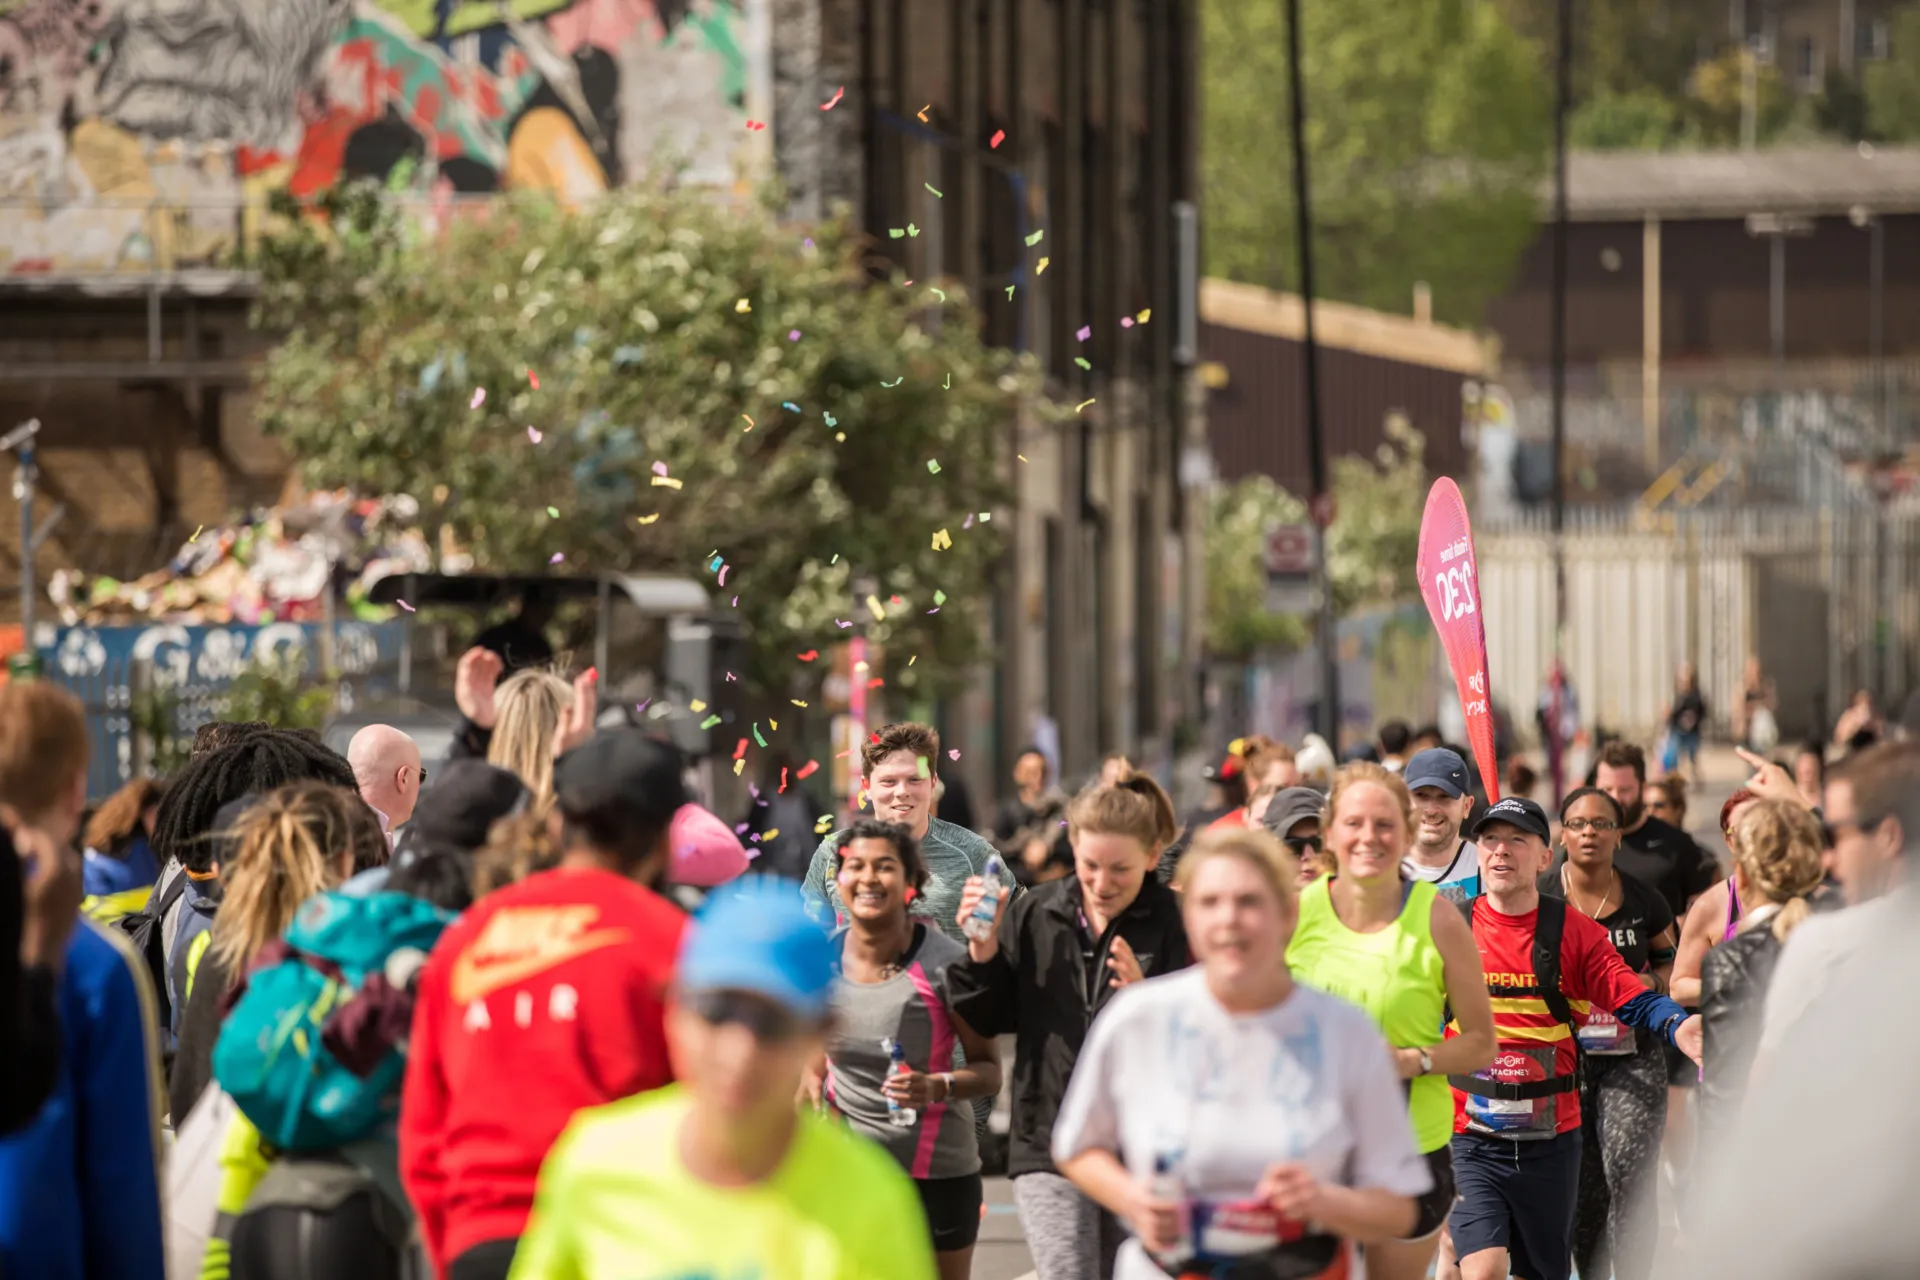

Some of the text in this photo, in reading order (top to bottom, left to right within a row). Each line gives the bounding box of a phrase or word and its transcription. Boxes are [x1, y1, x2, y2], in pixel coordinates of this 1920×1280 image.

[463, 983, 579, 1033] AIR
[1494, 1055, 1526, 1067] SPORT
[1490, 1067, 1531, 1076] HACKNEY
